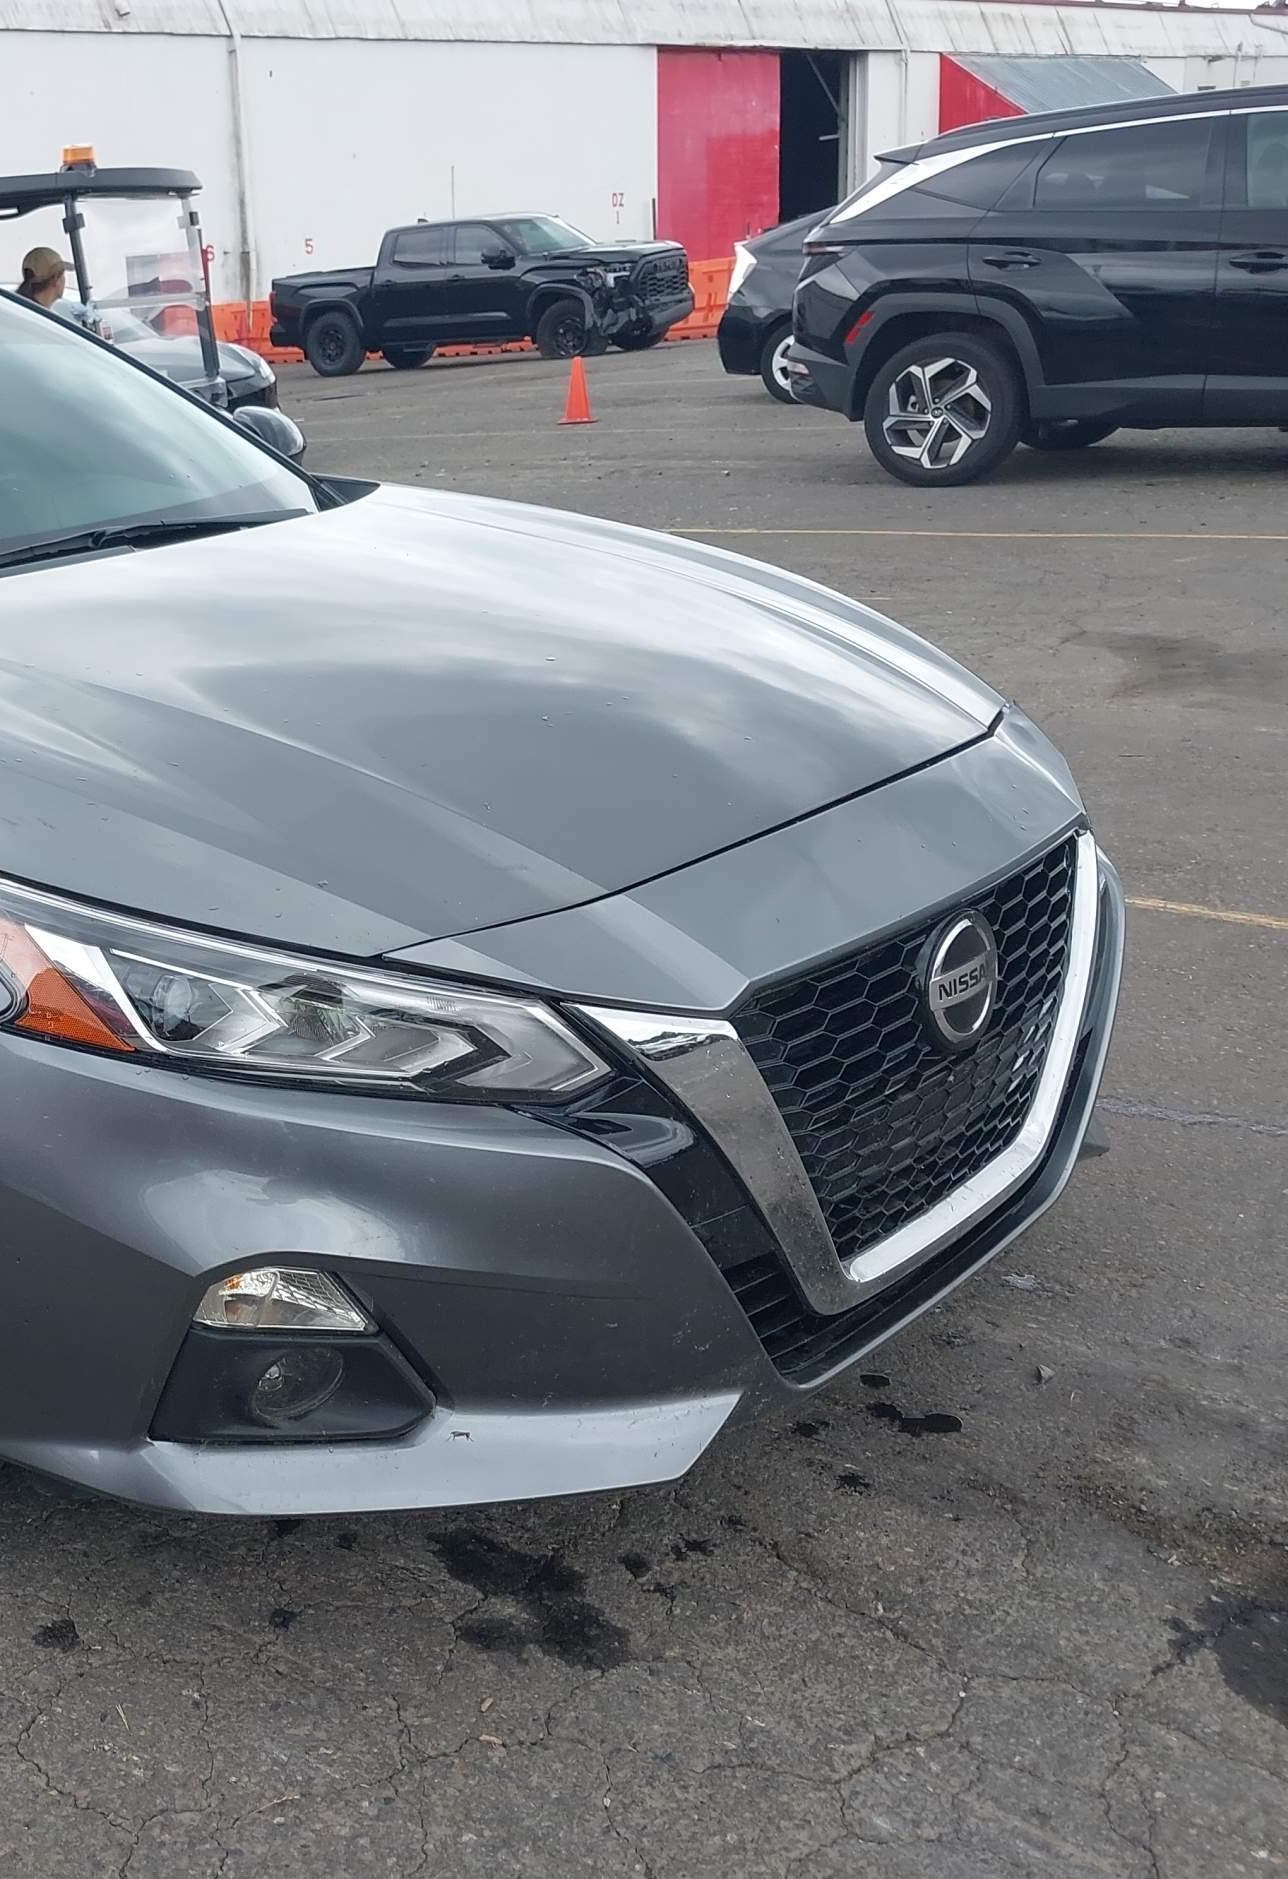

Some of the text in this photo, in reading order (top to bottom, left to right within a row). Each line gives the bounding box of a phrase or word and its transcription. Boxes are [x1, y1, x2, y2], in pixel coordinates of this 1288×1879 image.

[611, 192, 625, 208] DZ
[204, 244, 215, 262] 6
[304, 238, 314, 255] 5
